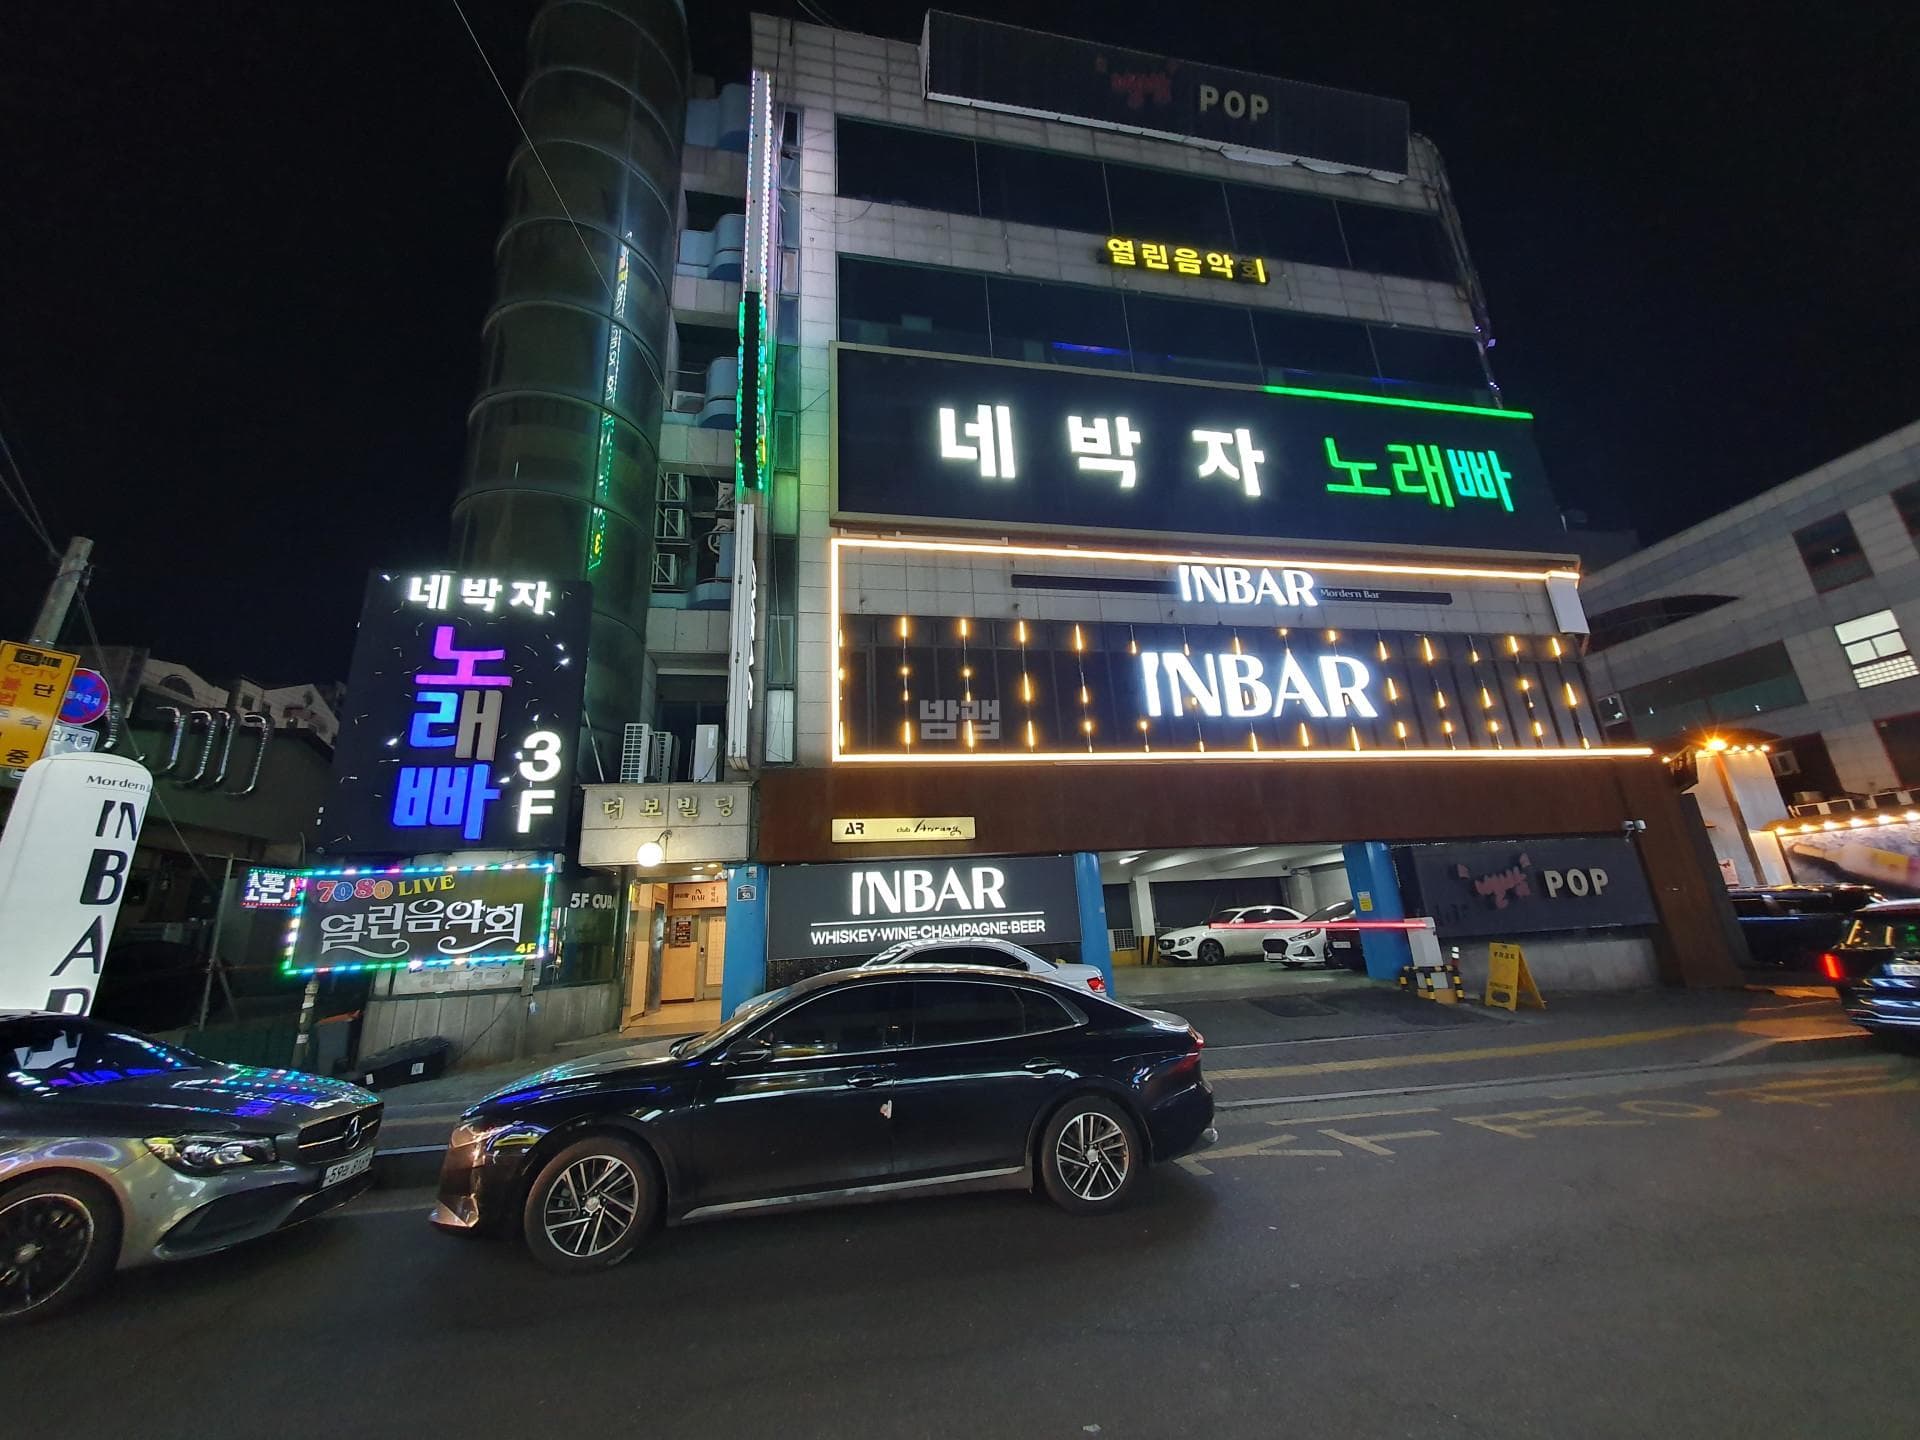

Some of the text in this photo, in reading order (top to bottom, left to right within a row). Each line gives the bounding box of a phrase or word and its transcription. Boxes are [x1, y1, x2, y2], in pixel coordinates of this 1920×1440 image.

[1199, 84, 1270, 122] POP
[1105, 237, 1268, 284] 열린음악회
[1324, 436, 1514, 513] 노래빠
[1178, 564, 1320, 607] INBAR
[1320, 589, 1380, 599] Mordern Bar
[6, 663, 61, 680] CCTV
[1140, 650, 1378, 719] INBAR
[50, 729, 92, 748] 인지역
[316, 875, 456, 903] 7080 LIVE
[570, 892, 590, 908] 5F
[851, 866, 1007, 916] INBAR
[1543, 868, 1609, 898] POP
[320, 899, 524, 956] 열린음악회
[515, 942, 537, 954] 4F
